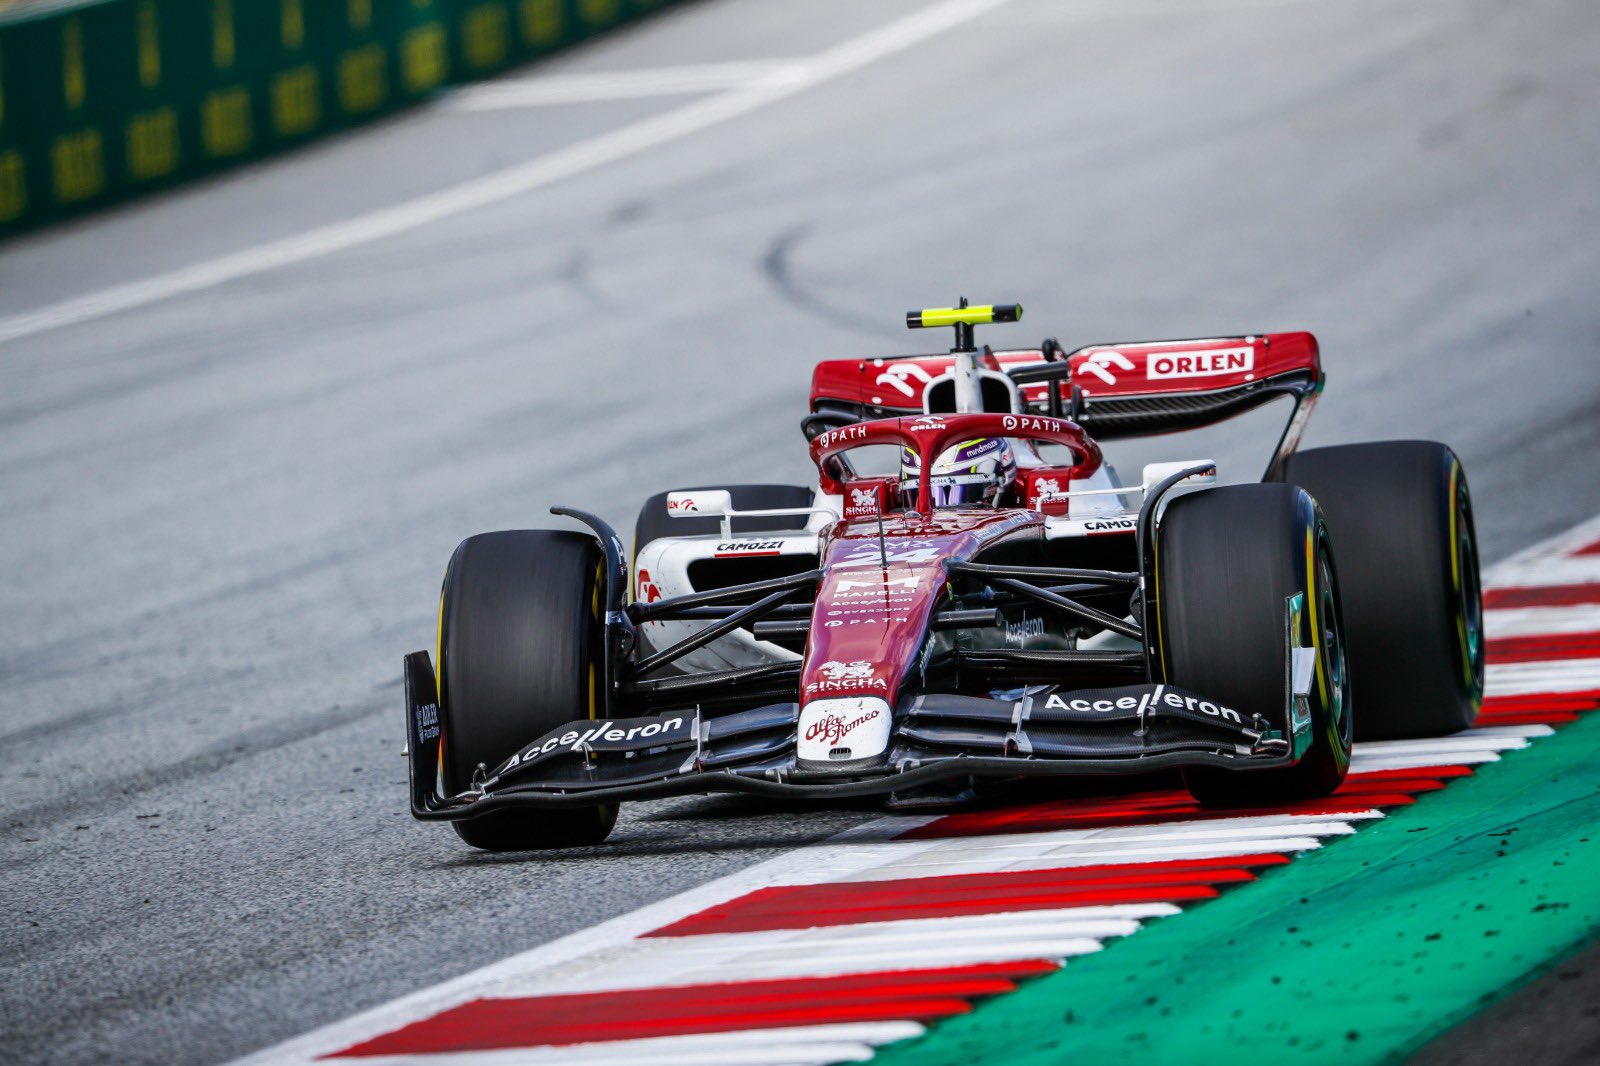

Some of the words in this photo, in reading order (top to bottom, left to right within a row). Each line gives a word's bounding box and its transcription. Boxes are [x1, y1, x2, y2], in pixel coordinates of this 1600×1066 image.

[1155, 353, 1246, 375] ORLEN
[910, 424, 947, 432] ORLEN
[1021, 418, 1060, 432] PATH
[831, 426, 867, 443] PATH
[966, 440, 998, 458] mindmaze
[1084, 520, 1137, 530] CAMO
[717, 541, 785, 551] CAMOZZI
[831, 548, 940, 568] 24
[833, 589, 917, 598] MARELLI
[850, 617, 908, 625] PATH
[806, 678, 888, 693] SINGHA
[805, 714, 846, 743] Alfa
[827, 710, 880, 745] Romeo
